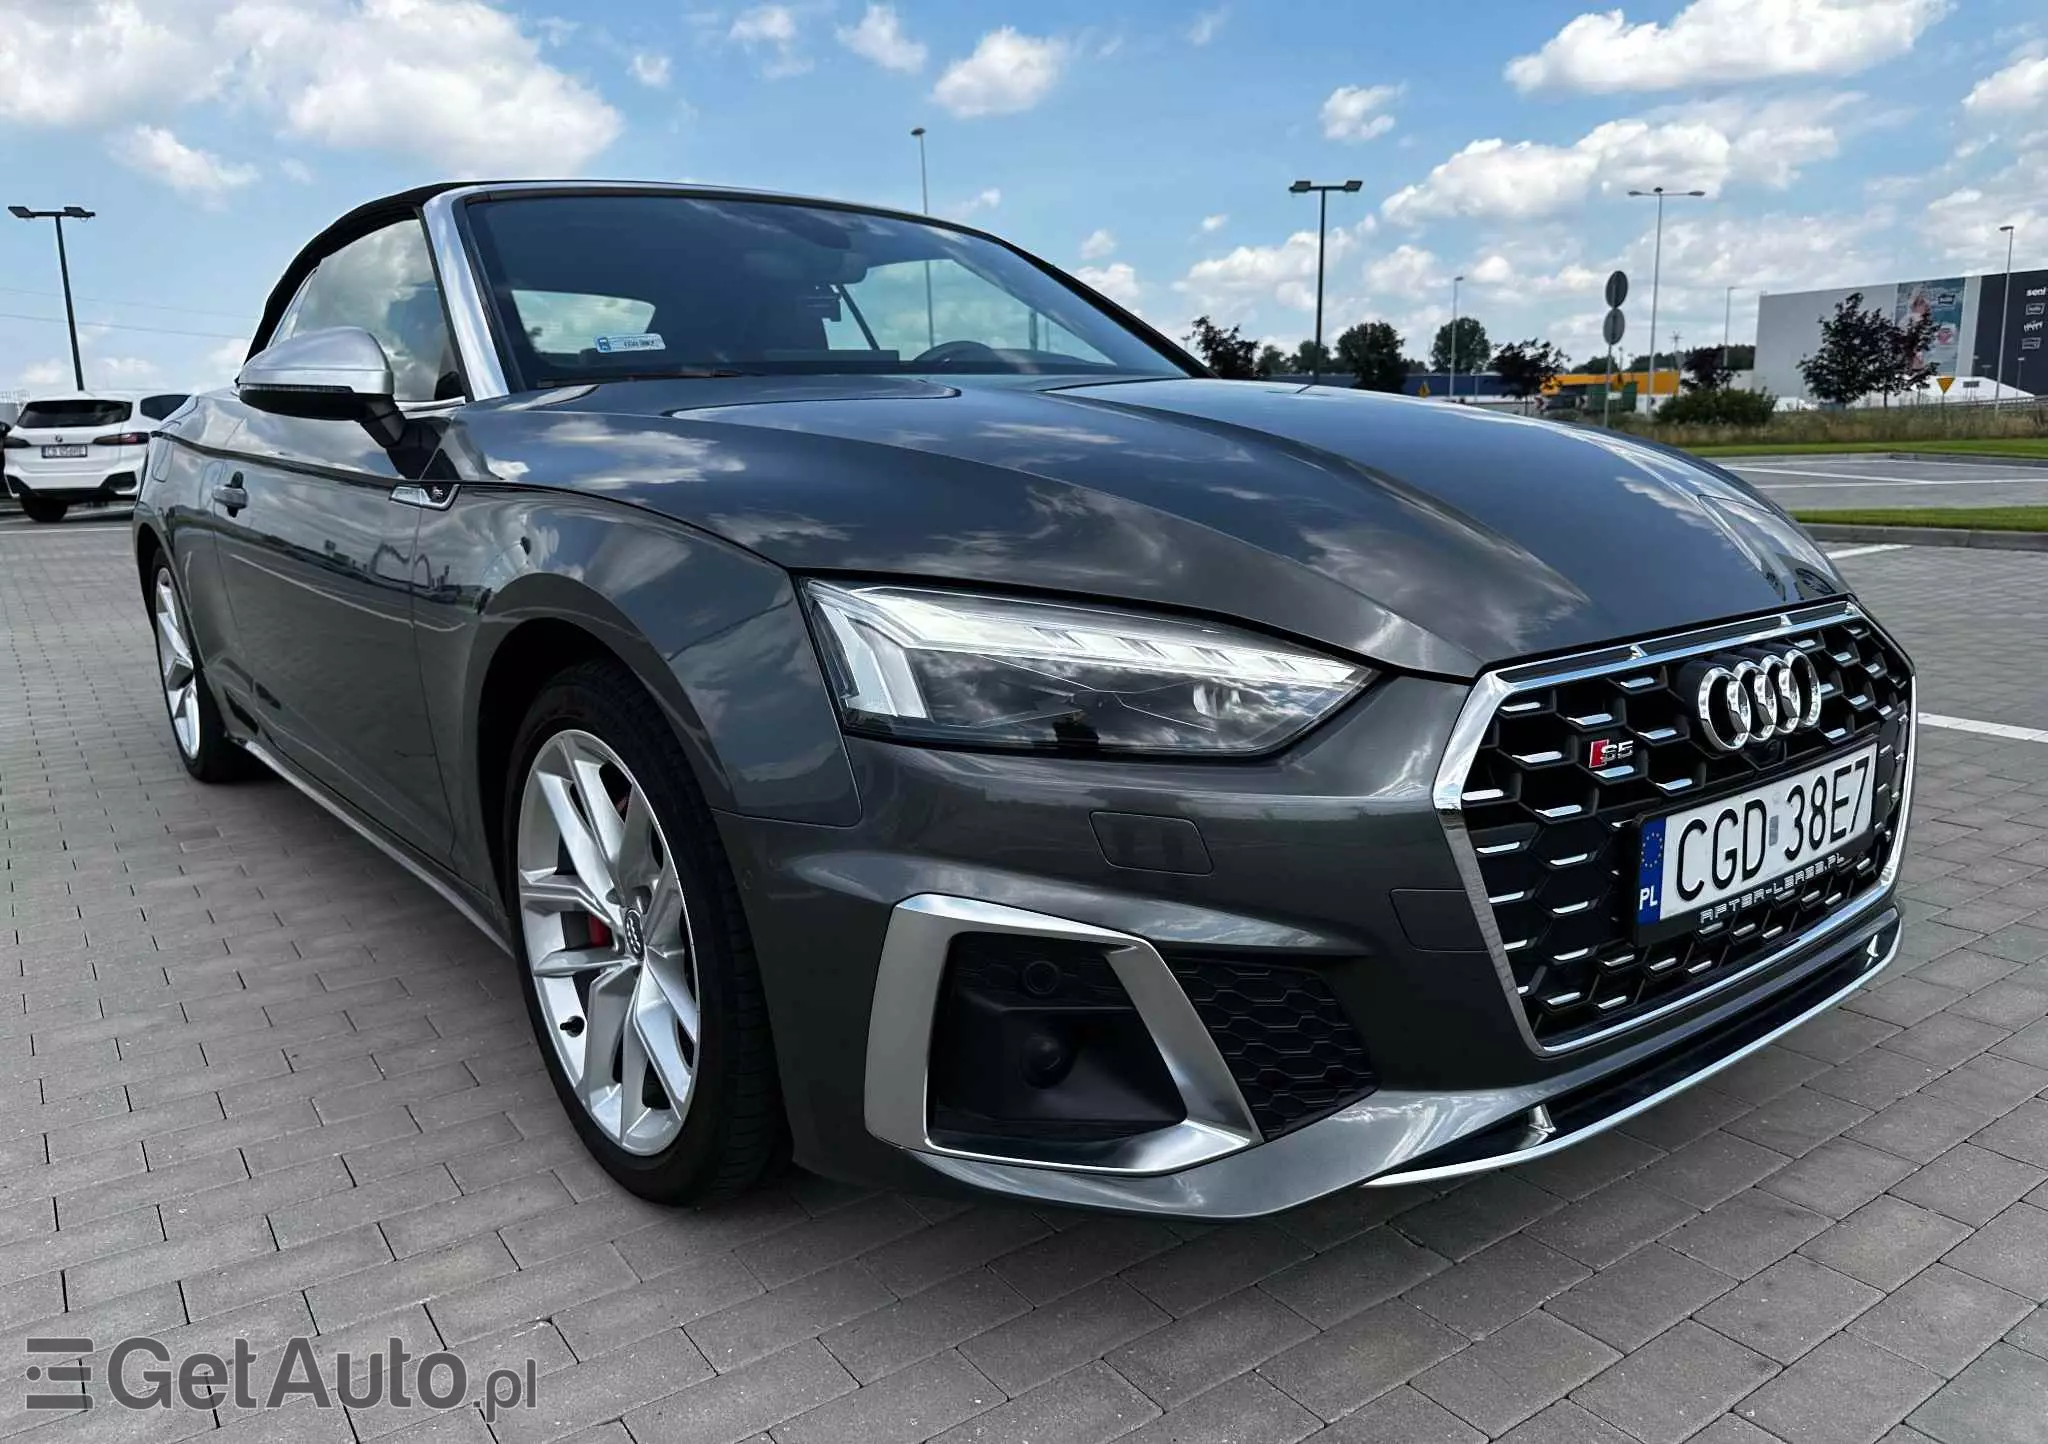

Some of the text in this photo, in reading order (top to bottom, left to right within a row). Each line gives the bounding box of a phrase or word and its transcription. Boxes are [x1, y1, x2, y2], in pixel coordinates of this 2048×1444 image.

[1599, 740, 1633, 762] S5
[1676, 756, 1870, 902] CGD 38E7
[1639, 885, 1658, 910] PL
